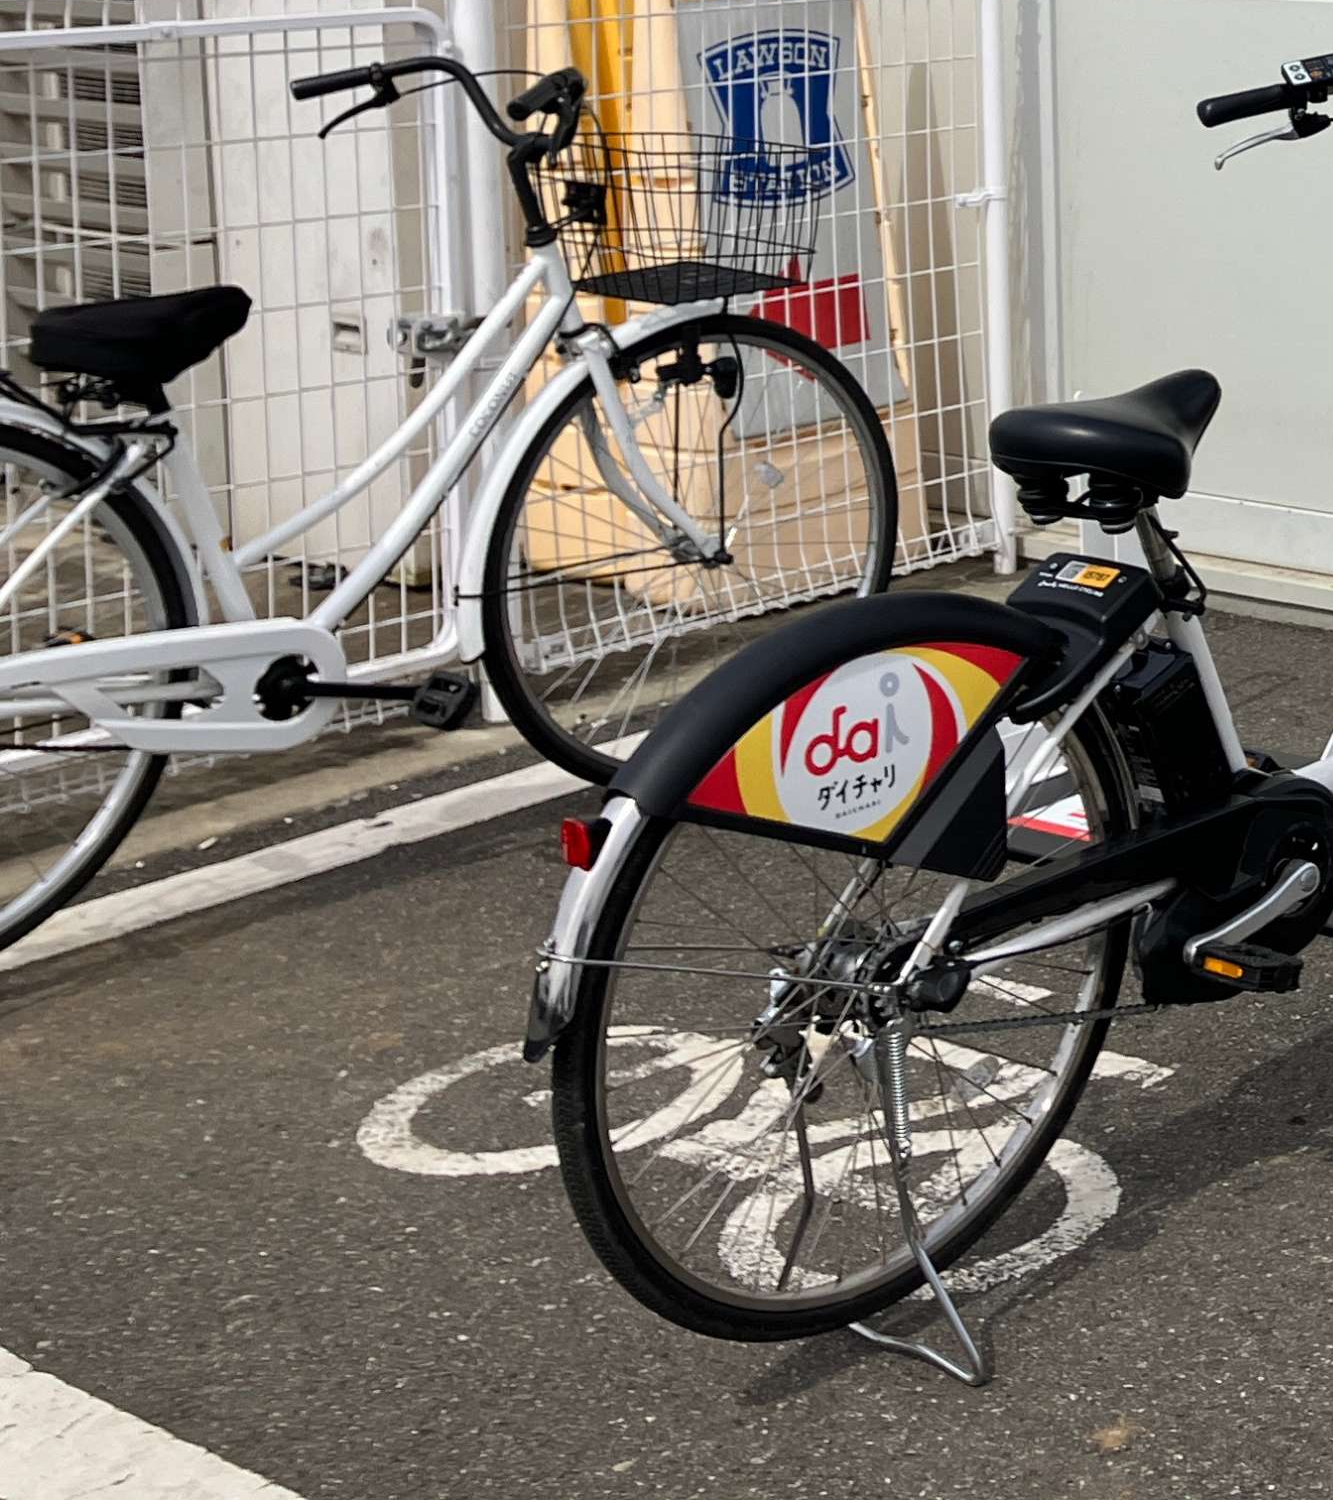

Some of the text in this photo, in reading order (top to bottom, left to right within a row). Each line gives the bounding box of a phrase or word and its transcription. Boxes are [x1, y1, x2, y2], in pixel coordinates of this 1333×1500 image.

[712, 42, 828, 82] LAWSON
[804, 672, 910, 776] dai
[817, 764, 896, 811] ダイチャリ
